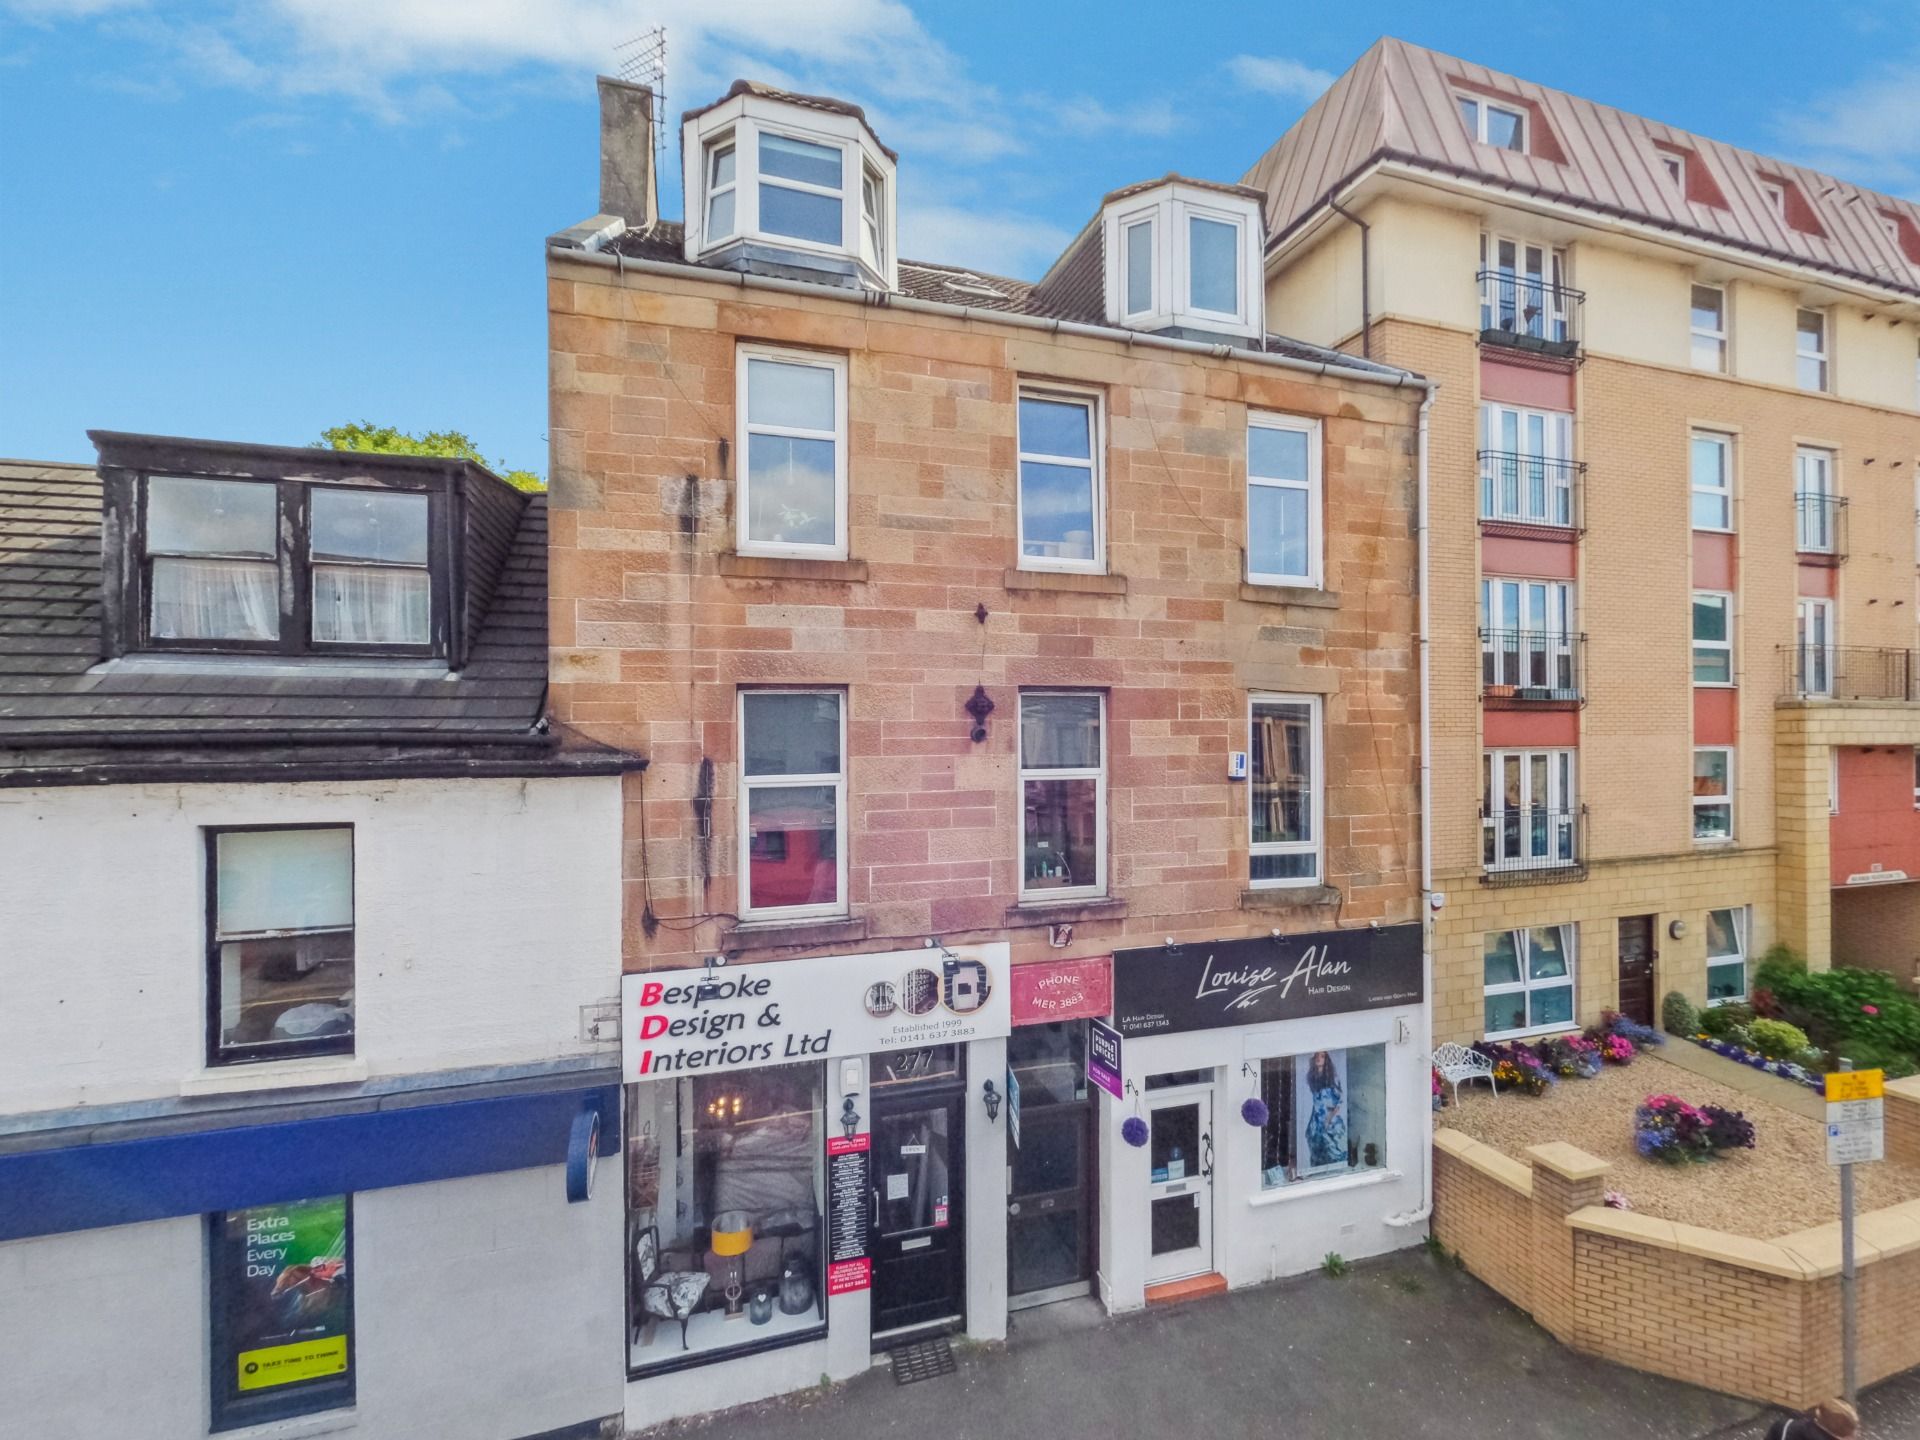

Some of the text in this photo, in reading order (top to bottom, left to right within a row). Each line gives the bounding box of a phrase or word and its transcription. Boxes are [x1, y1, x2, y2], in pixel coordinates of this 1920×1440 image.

[1195, 945, 1352, 1000] Louise Alan
[1038, 975, 1080, 990] PHONE
[1032, 992, 1084, 1009] MER 3883
[639, 1002, 781, 1040] Design &
[893, 1019, 962, 1034] Established 1999
[1129, 1022, 1142, 1030] 0141
[879, 1027, 975, 1046] Tel: 0141 637 3883
[1095, 1034, 1115, 1053] PURPLE
[639, 1029, 832, 1075] Interiors Ltd
[895, 1048, 934, 1073] 277
[1095, 1043, 1115, 1063] BRICKS
[247, 1216, 289, 1231] Extra
[247, 1230, 296, 1246] Places
[247, 1246, 288, 1263] Every
[247, 1264, 276, 1279] Day
